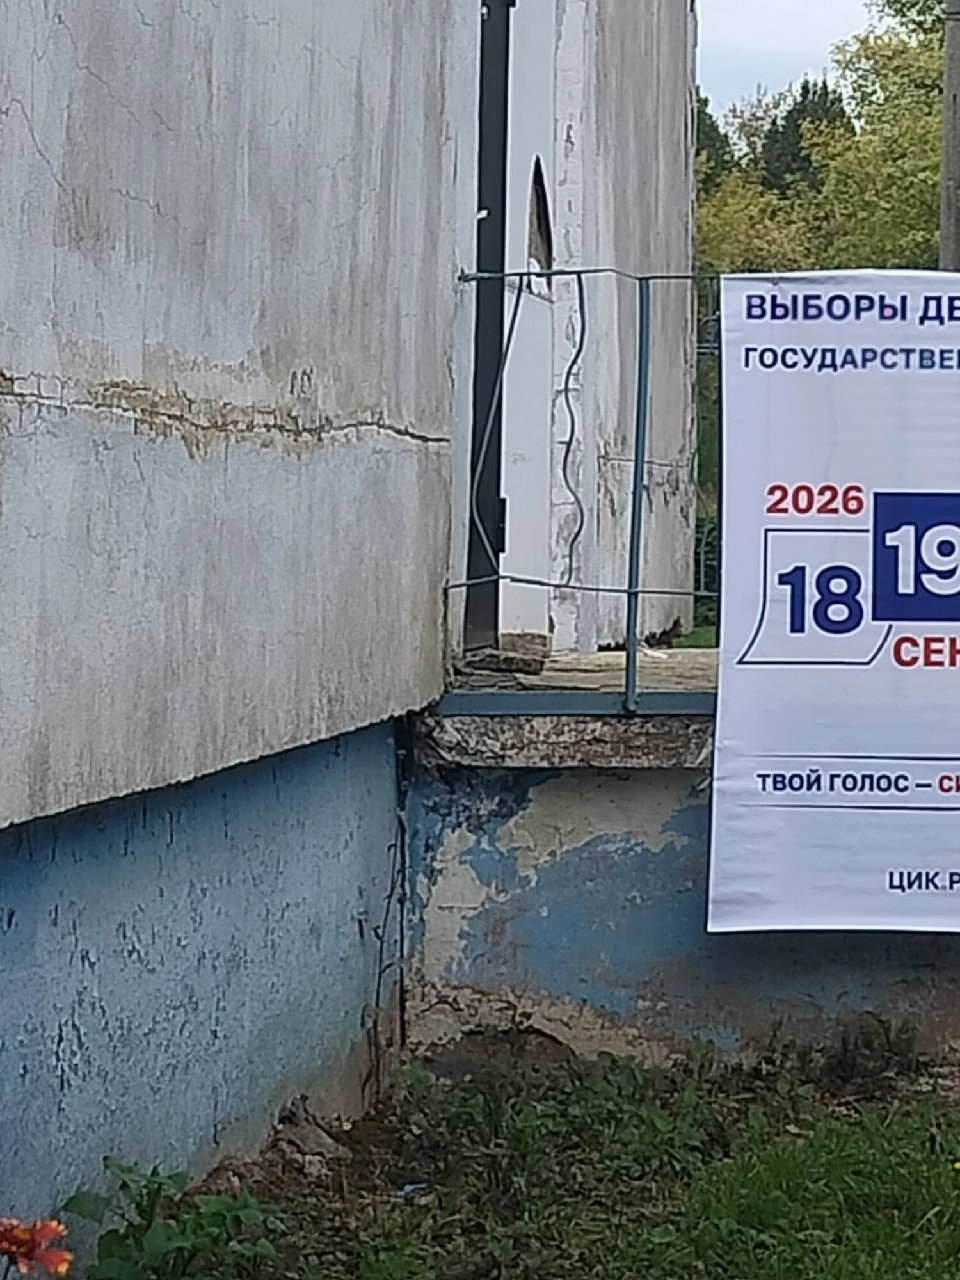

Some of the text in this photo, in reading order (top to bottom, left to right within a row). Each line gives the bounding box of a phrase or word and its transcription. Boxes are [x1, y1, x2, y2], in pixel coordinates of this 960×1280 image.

[746, 294, 908, 321] ВЫБОРЫ
[766, 485, 864, 514] 2026
[777, 565, 863, 634] 18
[757, 770, 821, 792] ТВОЙ
[829, 774, 909, 793] ГОЛОС
